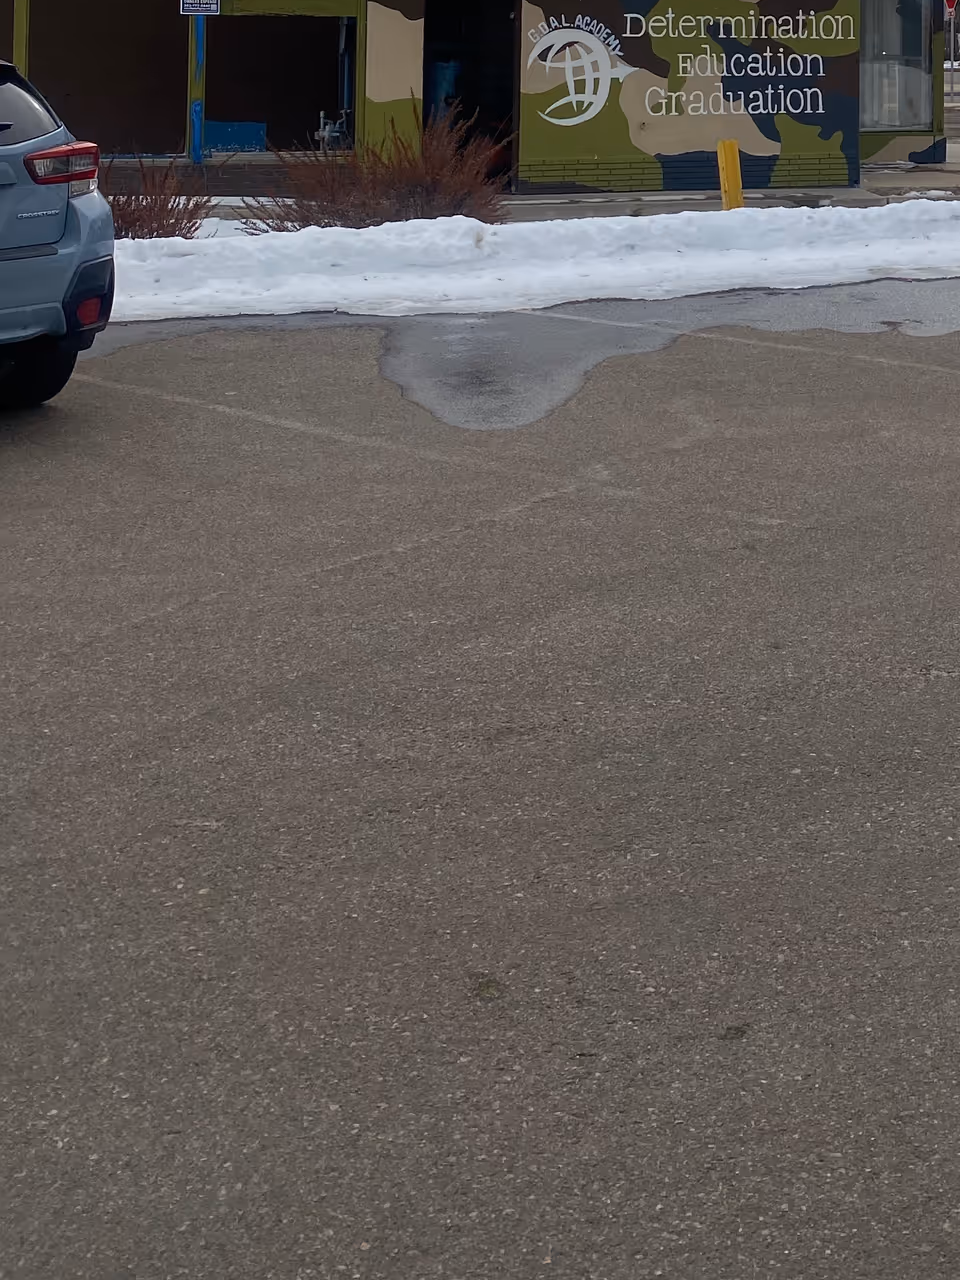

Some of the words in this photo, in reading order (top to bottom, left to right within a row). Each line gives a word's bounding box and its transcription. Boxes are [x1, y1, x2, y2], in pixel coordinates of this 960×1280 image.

[622, 7, 856, 40] Determination
[676, 44, 826, 78] Education
[645, 83, 826, 116] Graduation
